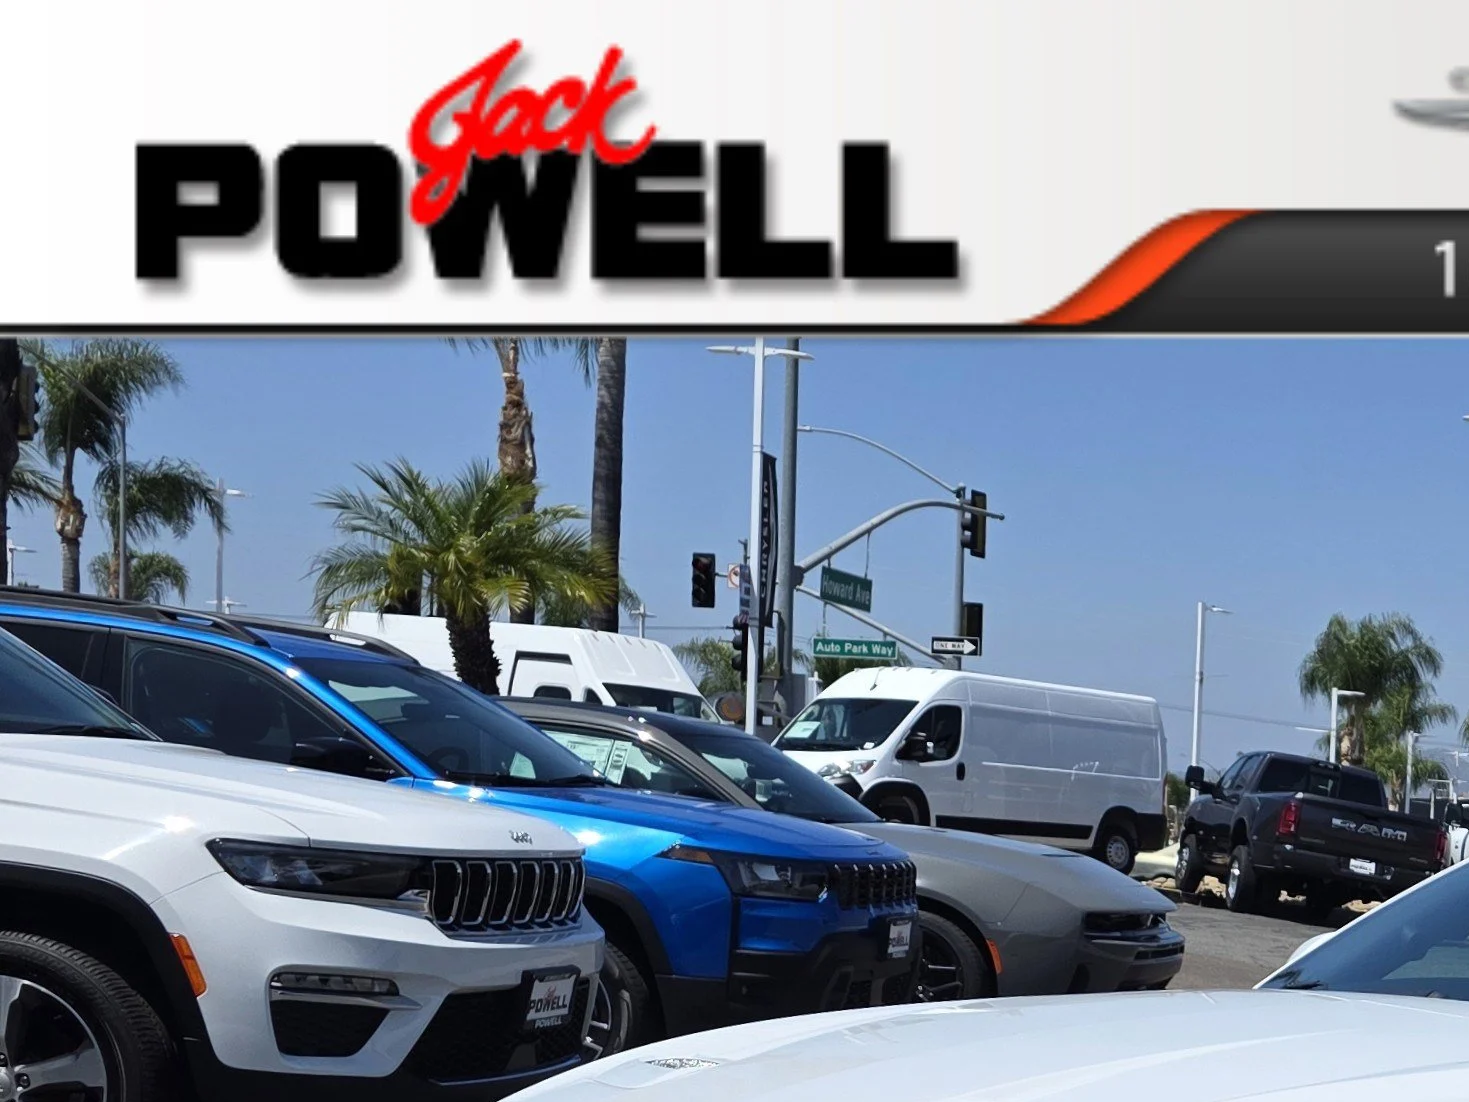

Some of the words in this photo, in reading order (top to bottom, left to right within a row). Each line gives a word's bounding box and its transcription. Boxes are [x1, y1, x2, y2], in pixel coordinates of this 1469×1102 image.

[822, 574, 854, 600] Howard
[855, 582, 870, 605] Ave
[816, 641, 841, 653] Auto
[844, 642, 868, 654] Park
[871, 644, 894, 656] Way
[1331, 817, 1408, 841] RAM
[530, 994, 568, 1014] POWELL
